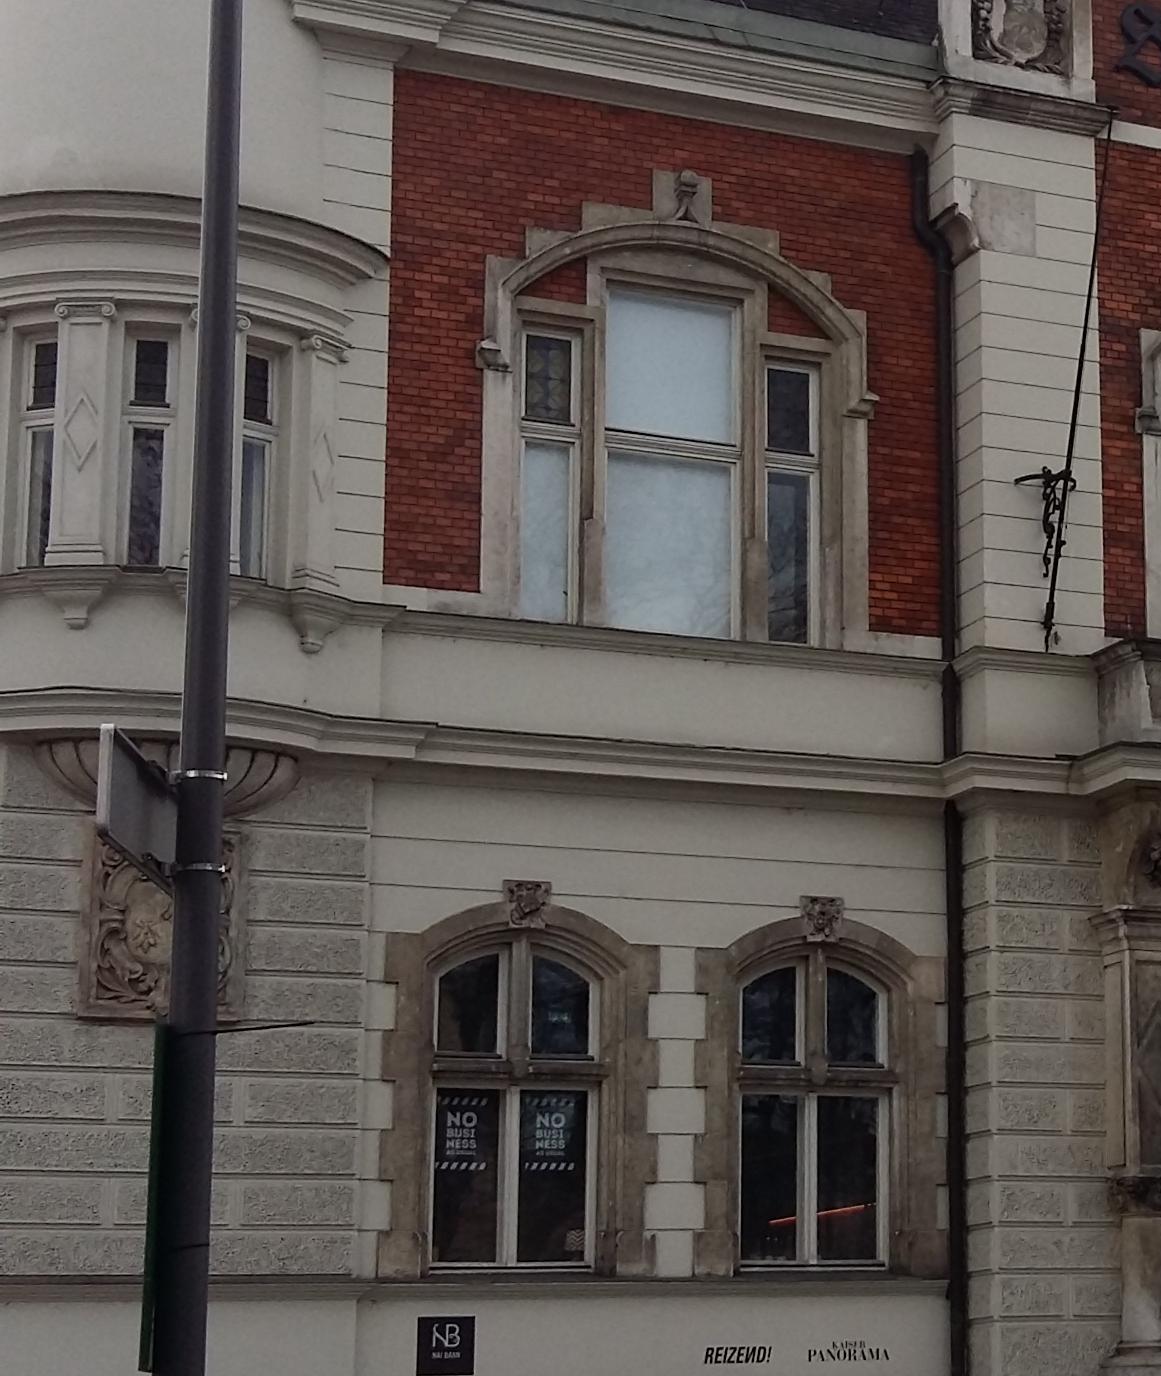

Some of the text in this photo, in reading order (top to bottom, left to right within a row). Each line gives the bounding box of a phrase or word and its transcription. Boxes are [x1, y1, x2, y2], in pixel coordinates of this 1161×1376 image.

[447, 1112, 477, 1127] NO
[536, 1112, 566, 1128] NO
[446, 1128, 476, 1138] BUSI
[535, 1129, 564, 1139] BUSI
[446, 1139, 476, 1149] NESS
[535, 1139, 566, 1149] NESS
[808, 1348, 890, 1362] PANORAMA
